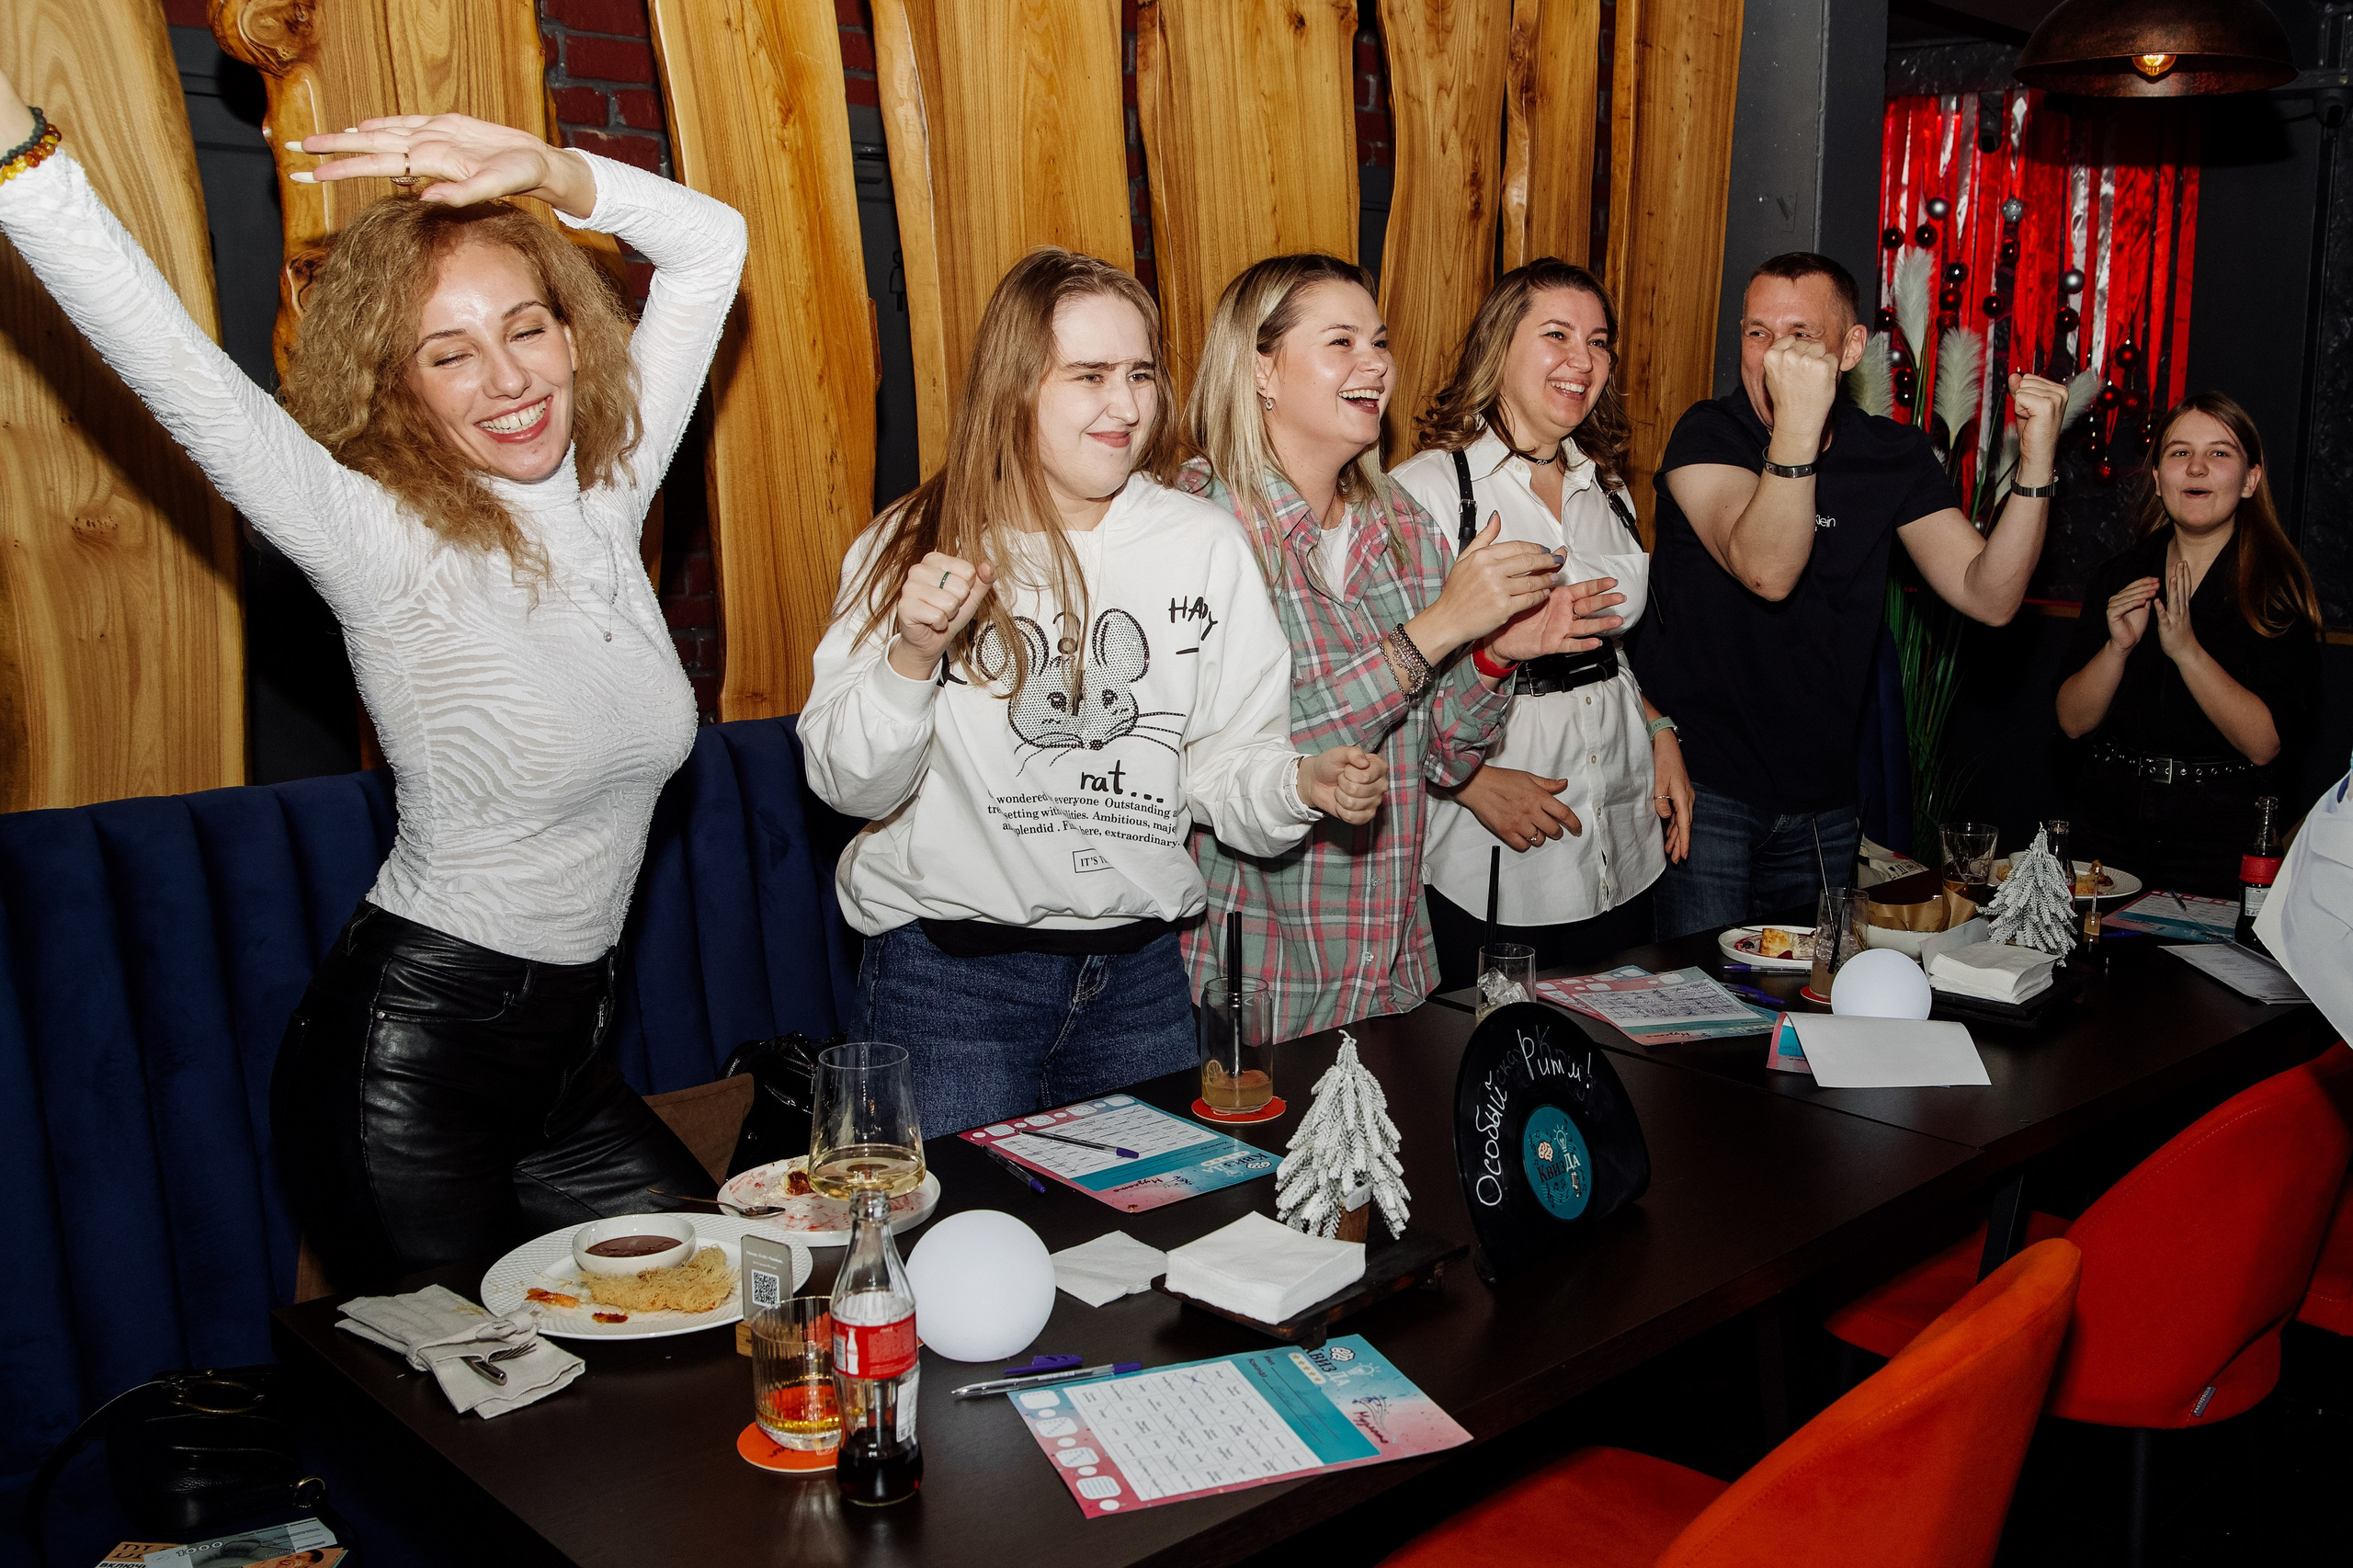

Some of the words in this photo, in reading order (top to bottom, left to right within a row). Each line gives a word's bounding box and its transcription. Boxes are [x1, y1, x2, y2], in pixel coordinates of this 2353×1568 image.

[995, 791, 1049, 805] wondered
[1053, 796, 1099, 807] everyone
[1104, 797, 1172, 820] Outstanding
[1004, 808, 1040, 821] setting
[1092, 811, 1151, 828] Ambitious,
[1153, 822, 1177, 835] maje
[1014, 823, 1054, 837] plendid
[1104, 829, 1181, 848] extraordinary.
[1080, 856, 1098, 868] IT'S
[1475, 1070, 1507, 1206] Особый
[176, 1540, 223, 1557] 1000
